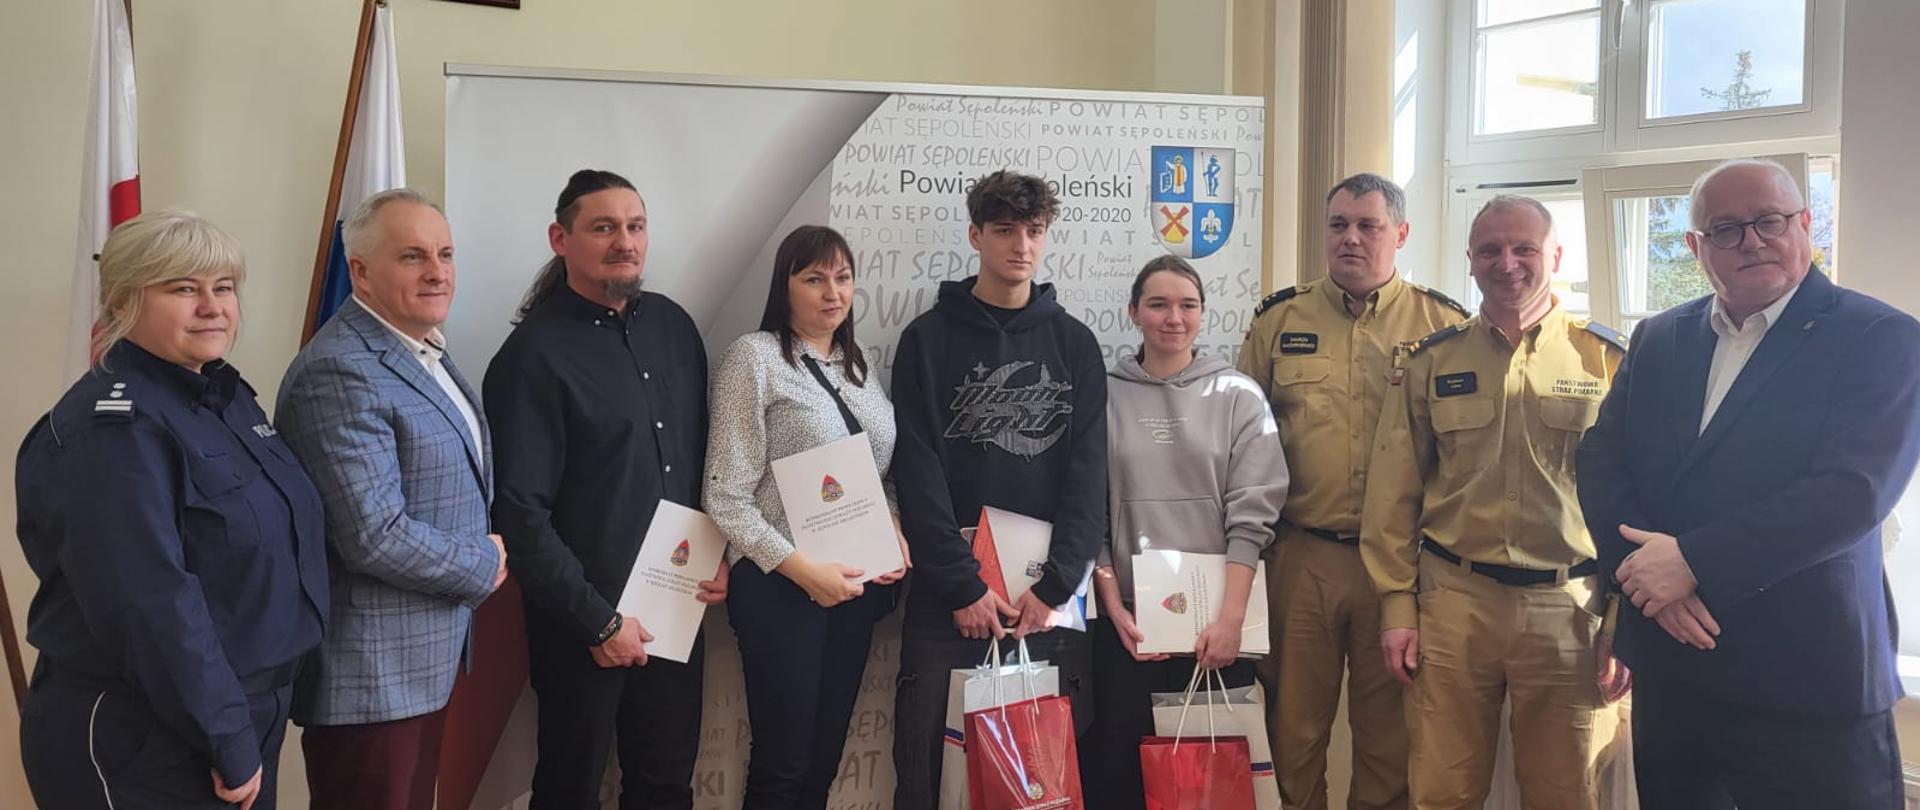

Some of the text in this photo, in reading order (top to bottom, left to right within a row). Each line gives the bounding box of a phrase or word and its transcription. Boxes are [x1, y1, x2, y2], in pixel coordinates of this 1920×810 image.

[896, 95, 953, 112] Powiat
[1050, 102, 1167, 121] POWIAT
[903, 115, 1033, 140] SĘPOLEŃSKI
[1041, 123, 1114, 137] POWIAT
[1120, 126, 1228, 142] SĘPOLEŃSKI
[844, 142, 1030, 169] POWIAT SĘPOLEŃSKI
[1036, 145, 1150, 173] POWIA
[900, 169, 986, 195] Powia
[1051, 230, 1136, 247] WIAT
[856, 248, 901, 280] IAT
